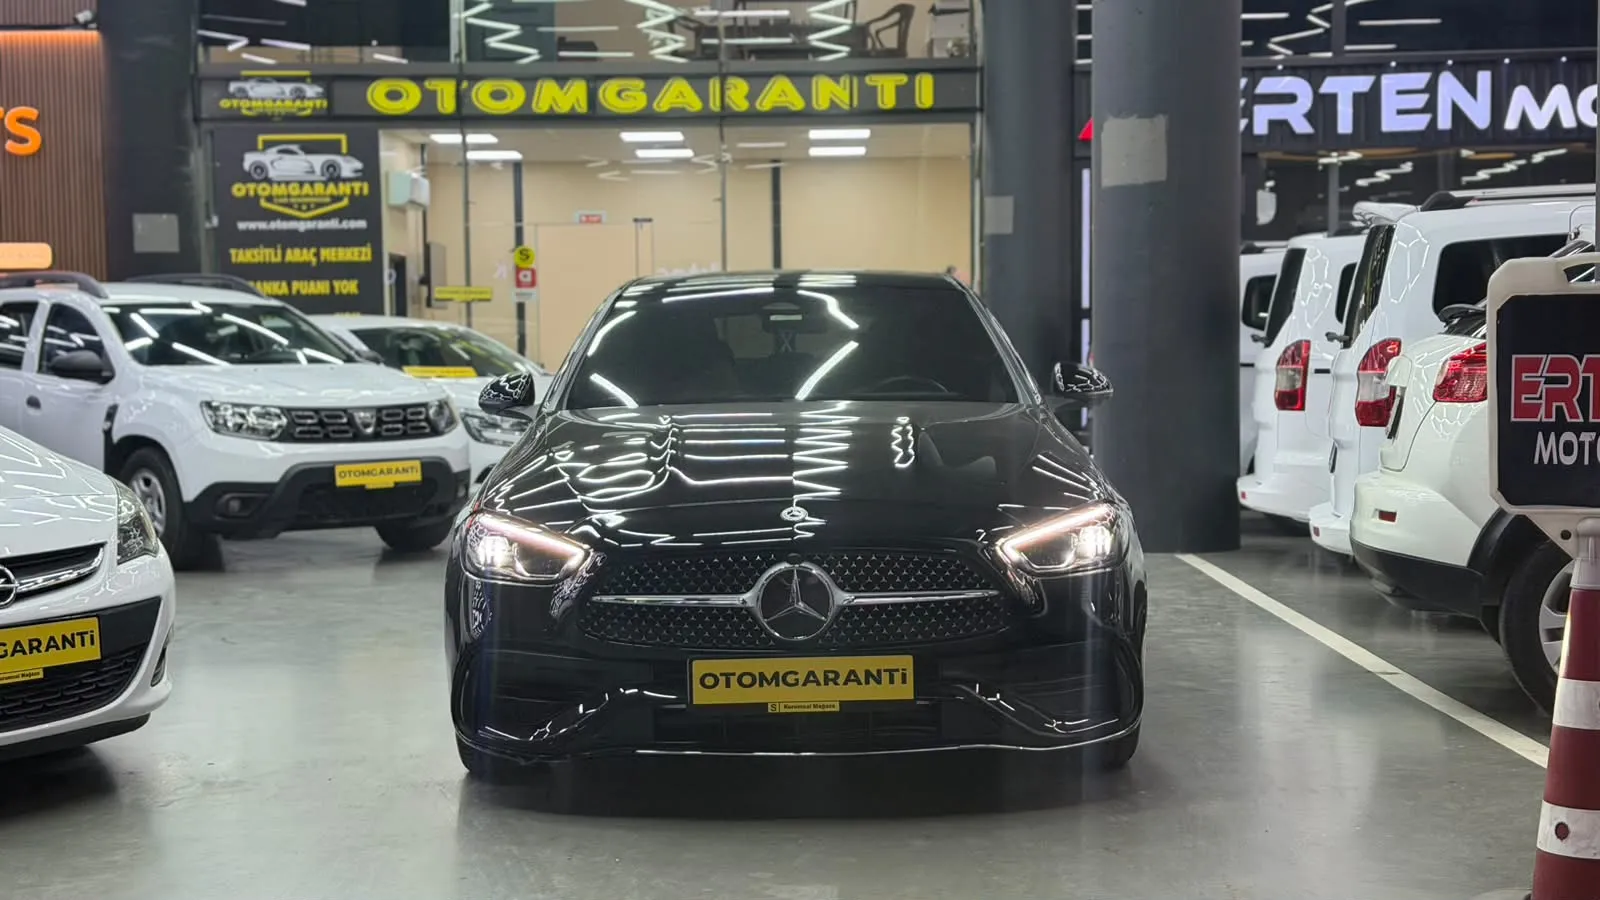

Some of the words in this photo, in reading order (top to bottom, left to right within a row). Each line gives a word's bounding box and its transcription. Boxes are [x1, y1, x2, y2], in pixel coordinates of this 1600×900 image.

[366, 72, 934, 115] OTOMGARANTI
[1239, 70, 1492, 136] RTEN
[0, 105, 42, 157] S
[231, 182, 369, 197] OTOMGARANTI
[236, 217, 368, 233] www.otomgaranti.com
[285, 247, 317, 267] ARAÇ
[291, 279, 331, 296] PUANI
[333, 279, 360, 296] YOK
[1533, 431, 1600, 465] MOT
[699, 667, 908, 690] OTOMGARANTi
